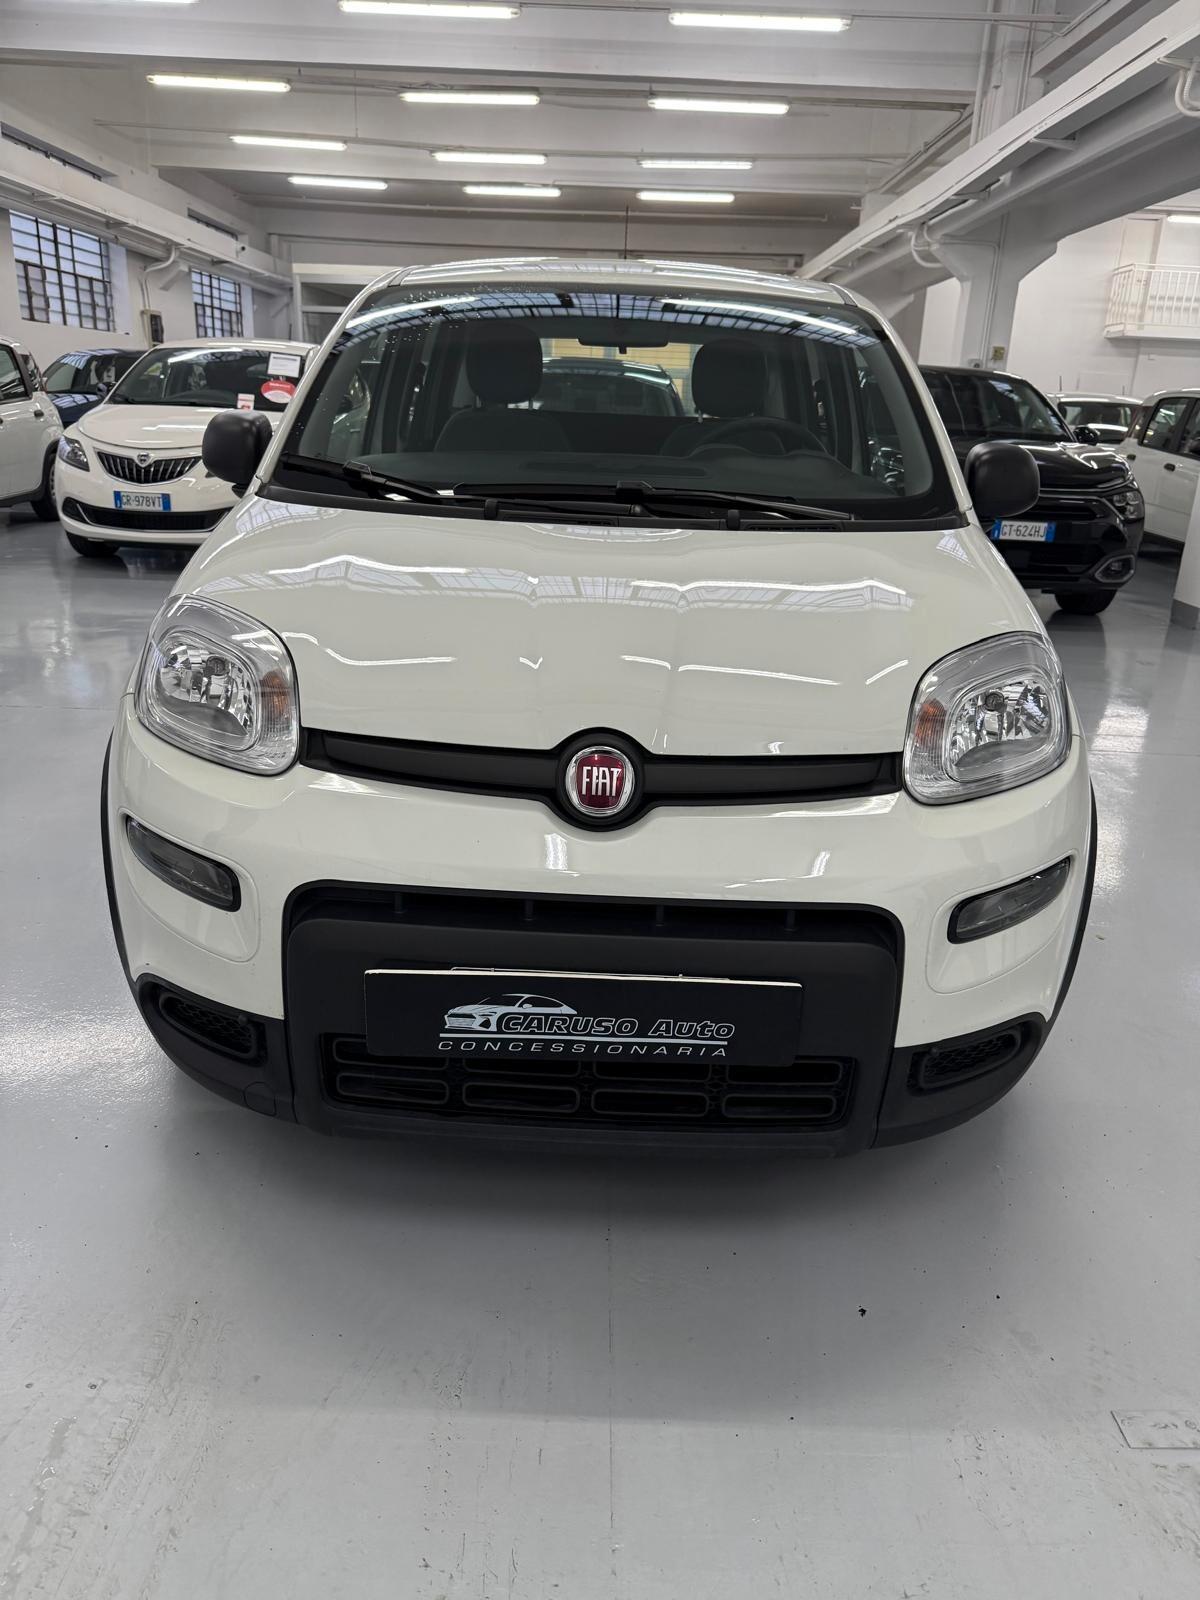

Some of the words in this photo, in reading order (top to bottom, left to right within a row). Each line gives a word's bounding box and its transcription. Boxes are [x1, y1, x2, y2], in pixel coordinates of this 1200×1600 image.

[581, 766, 622, 797] FIAT
[501, 1014, 639, 1036] CARUSO
[648, 1019, 735, 1039] Auto
[438, 1041, 727, 1057] CONCESSIONARIA
